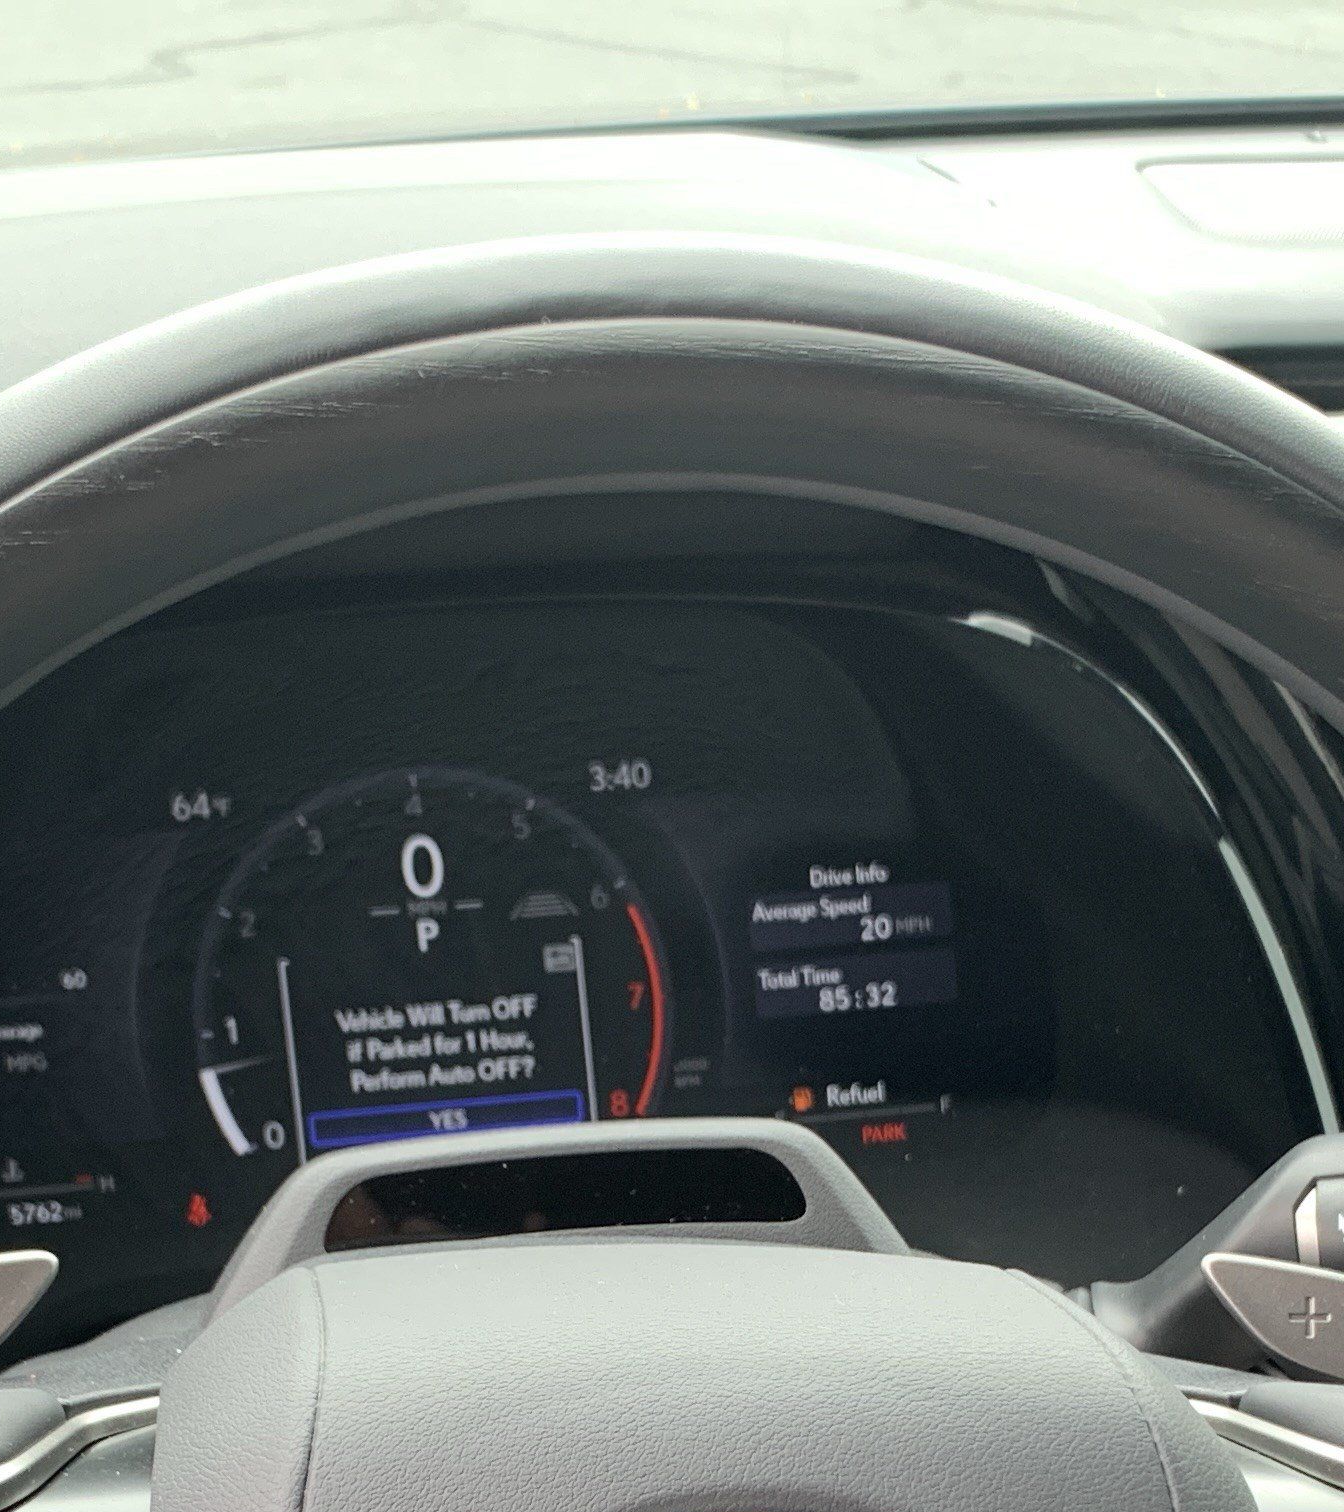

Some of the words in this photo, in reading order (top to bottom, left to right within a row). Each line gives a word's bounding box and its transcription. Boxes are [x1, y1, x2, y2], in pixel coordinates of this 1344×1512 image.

[589, 758, 652, 792] 3:40
[401, 832, 445, 899] 0
[809, 866, 852, 889] Drive
[855, 862, 889, 884] Info
[753, 901, 817, 923] Average
[819, 893, 871, 918] Speed
[415, 917, 439, 953] P
[860, 914, 894, 942] 20
[895, 914, 933, 937] MPH
[61, 968, 88, 991] 60
[757, 967, 798, 991] Total
[802, 964, 843, 986] Time
[626, 982, 645, 1011] 7
[334, 1005, 405, 1033] Vehicle
[406, 1001, 445, 1027] Will
[448, 999, 491, 1024] Turn
[492, 993, 537, 1020] OFF
[223, 1016, 239, 1046] 1
[366, 1033, 431, 1061] Parked
[434, 1031, 461, 1056] for
[465, 1029, 477, 1053] 1
[350, 1067, 426, 1094] Perform
[428, 1062, 476, 1086] Auto
[477, 1055, 535, 1083] OFF?
[609, 1088, 630, 1117] 8
[826, 1079, 886, 1108] Refuel
[428, 1108, 469, 1131] YES
[861, 1121, 907, 1145] PARK
[262, 1121, 285, 1150] 0
